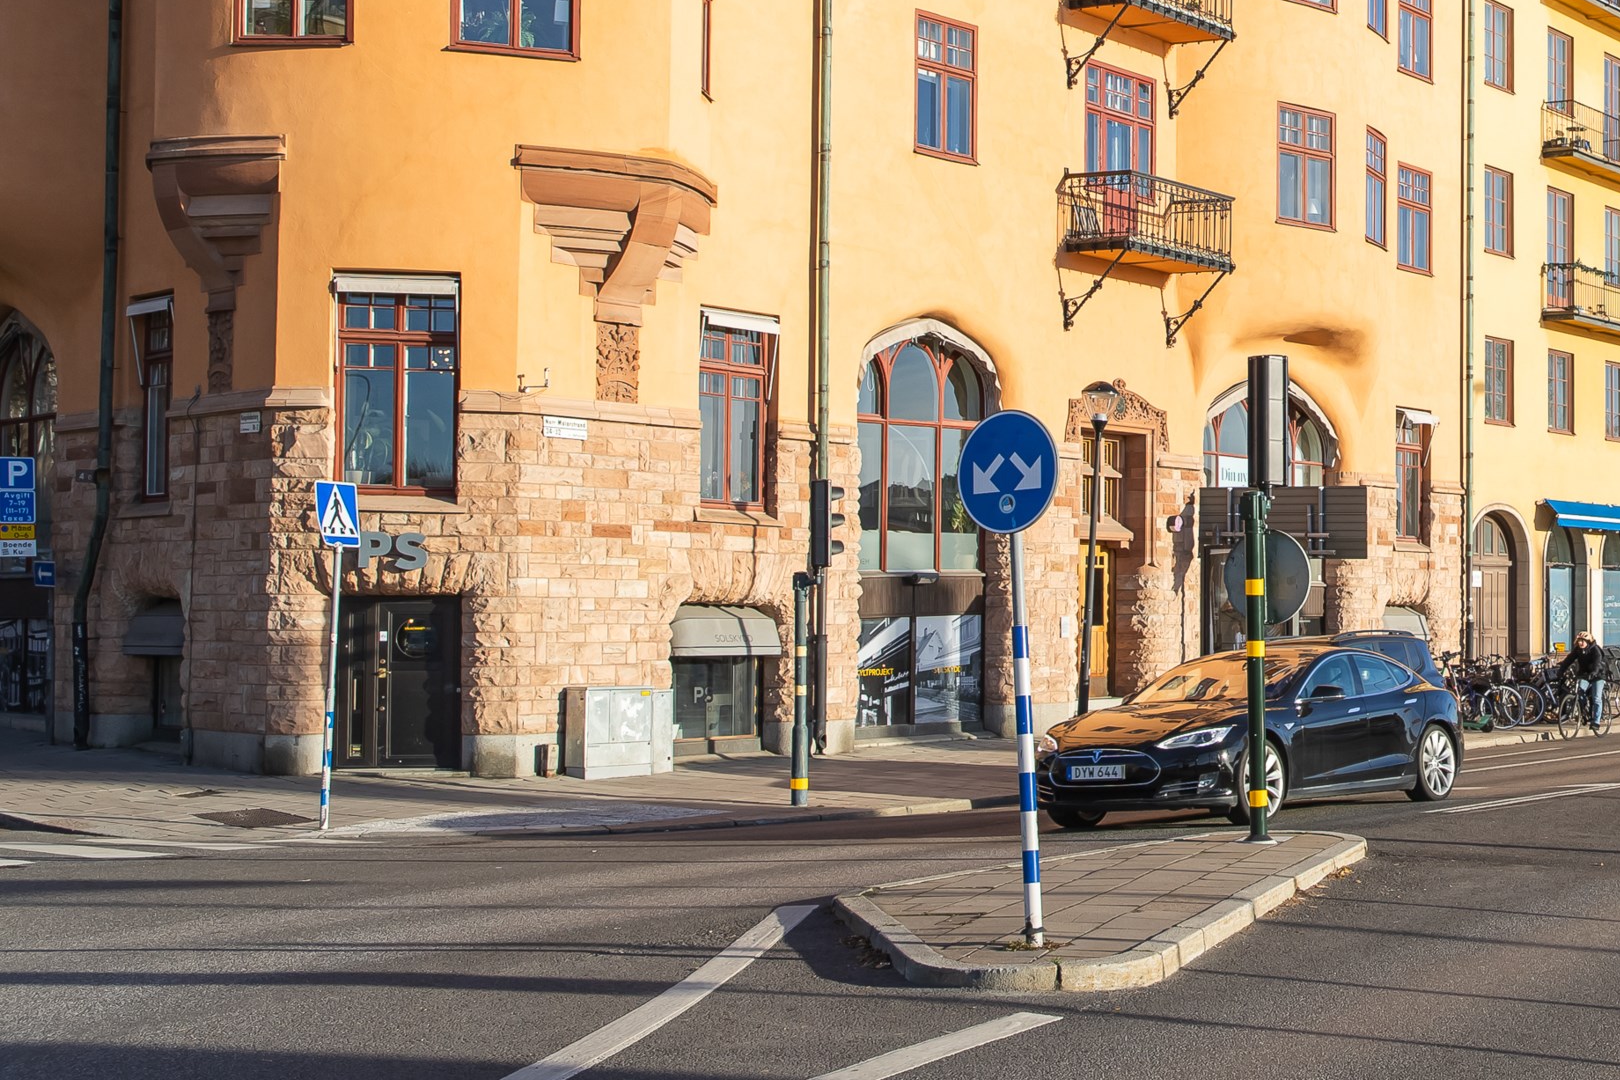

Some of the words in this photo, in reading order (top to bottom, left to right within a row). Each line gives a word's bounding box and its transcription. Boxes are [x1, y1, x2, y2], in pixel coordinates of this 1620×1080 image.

[8, 461, 28, 486] P
[4, 492, 30, 500] Avgift
[358, 531, 429, 570] PS
[1075, 767, 1095, 778] DYW
[1097, 766, 1118, 778] 644
